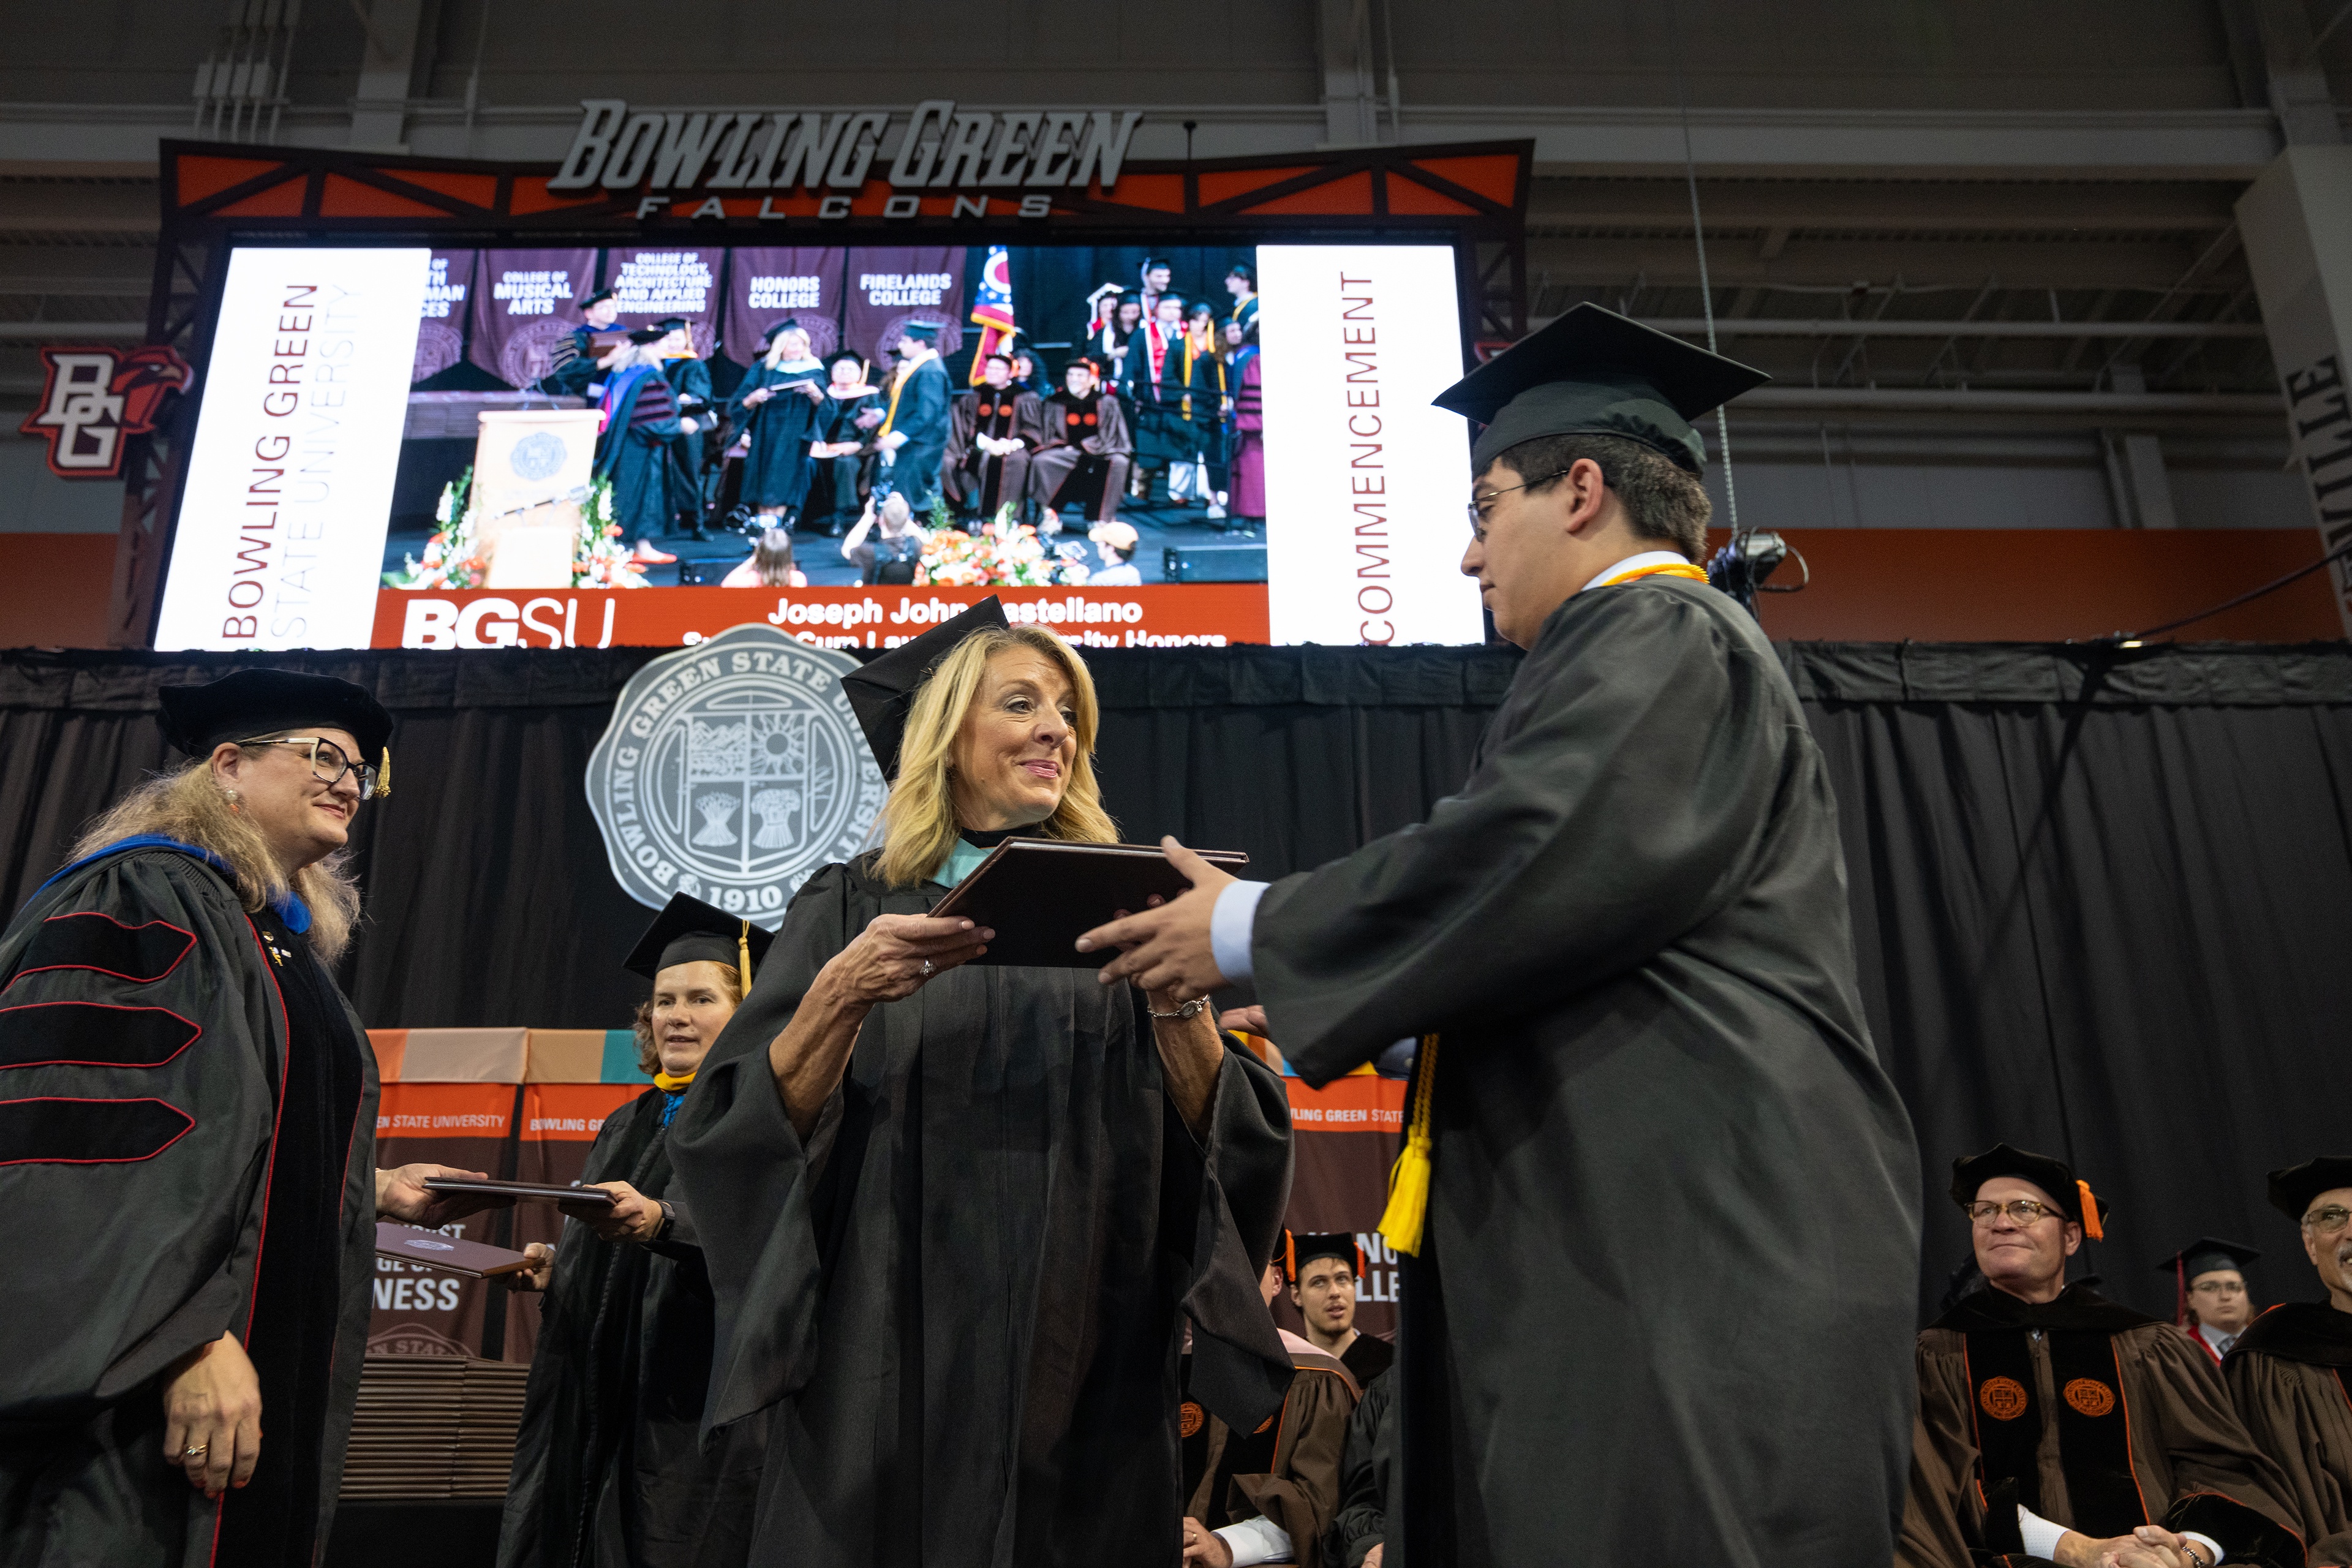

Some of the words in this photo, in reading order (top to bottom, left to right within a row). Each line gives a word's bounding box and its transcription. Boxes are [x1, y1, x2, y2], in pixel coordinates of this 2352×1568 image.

[546, 99, 889, 189] BOWLING
[888, 99, 1142, 189] GREEN
[635, 195, 1052, 221] FALCONS
[635, 252, 682, 265] COLLEGE
[682, 252, 699, 264] OF
[503, 271, 551, 283] COLLEGE
[551, 270, 568, 283] OF
[614, 274, 713, 288] ARCHITECTURE
[750, 276, 820, 293] HONORS
[860, 273, 952, 290] FIRELANDS
[493, 282, 574, 300] MUSICAL
[618, 288, 649, 300] AND
[650, 287, 706, 300] APPLIED
[869, 289, 942, 306] COLLEGE
[507, 298, 555, 315] ARTS
[616, 299, 706, 313] ENGINEERING
[748, 292, 820, 309] COLLEGE
[295, 284, 363, 503] UNIVERSITY
[222, 435, 291, 638] BOWLING
[263, 285, 318, 417] GREEN
[1340, 271, 1395, 646] COMMENCEMENT
[271, 522, 323, 638] STATE
[768, 597, 883, 629] Joseph
[890, 597, 970, 624] John
[981, 597, 1143, 624] astellano
[402, 597, 616, 649] BGSU
[731, 650, 832, 693] STATE
[630, 657, 722, 738] GREEN
[613, 745, 678, 886] BOWLING
[708, 885, 783, 912] 1910
[393, 1114, 431, 1128] STATE
[432, 1114, 505, 1128] UNIVERSITY
[530, 1117, 586, 1132] BOWLING
[1325, 1109, 1368, 1123] GREEN
[1371, 1109, 1404, 1123] STATE
